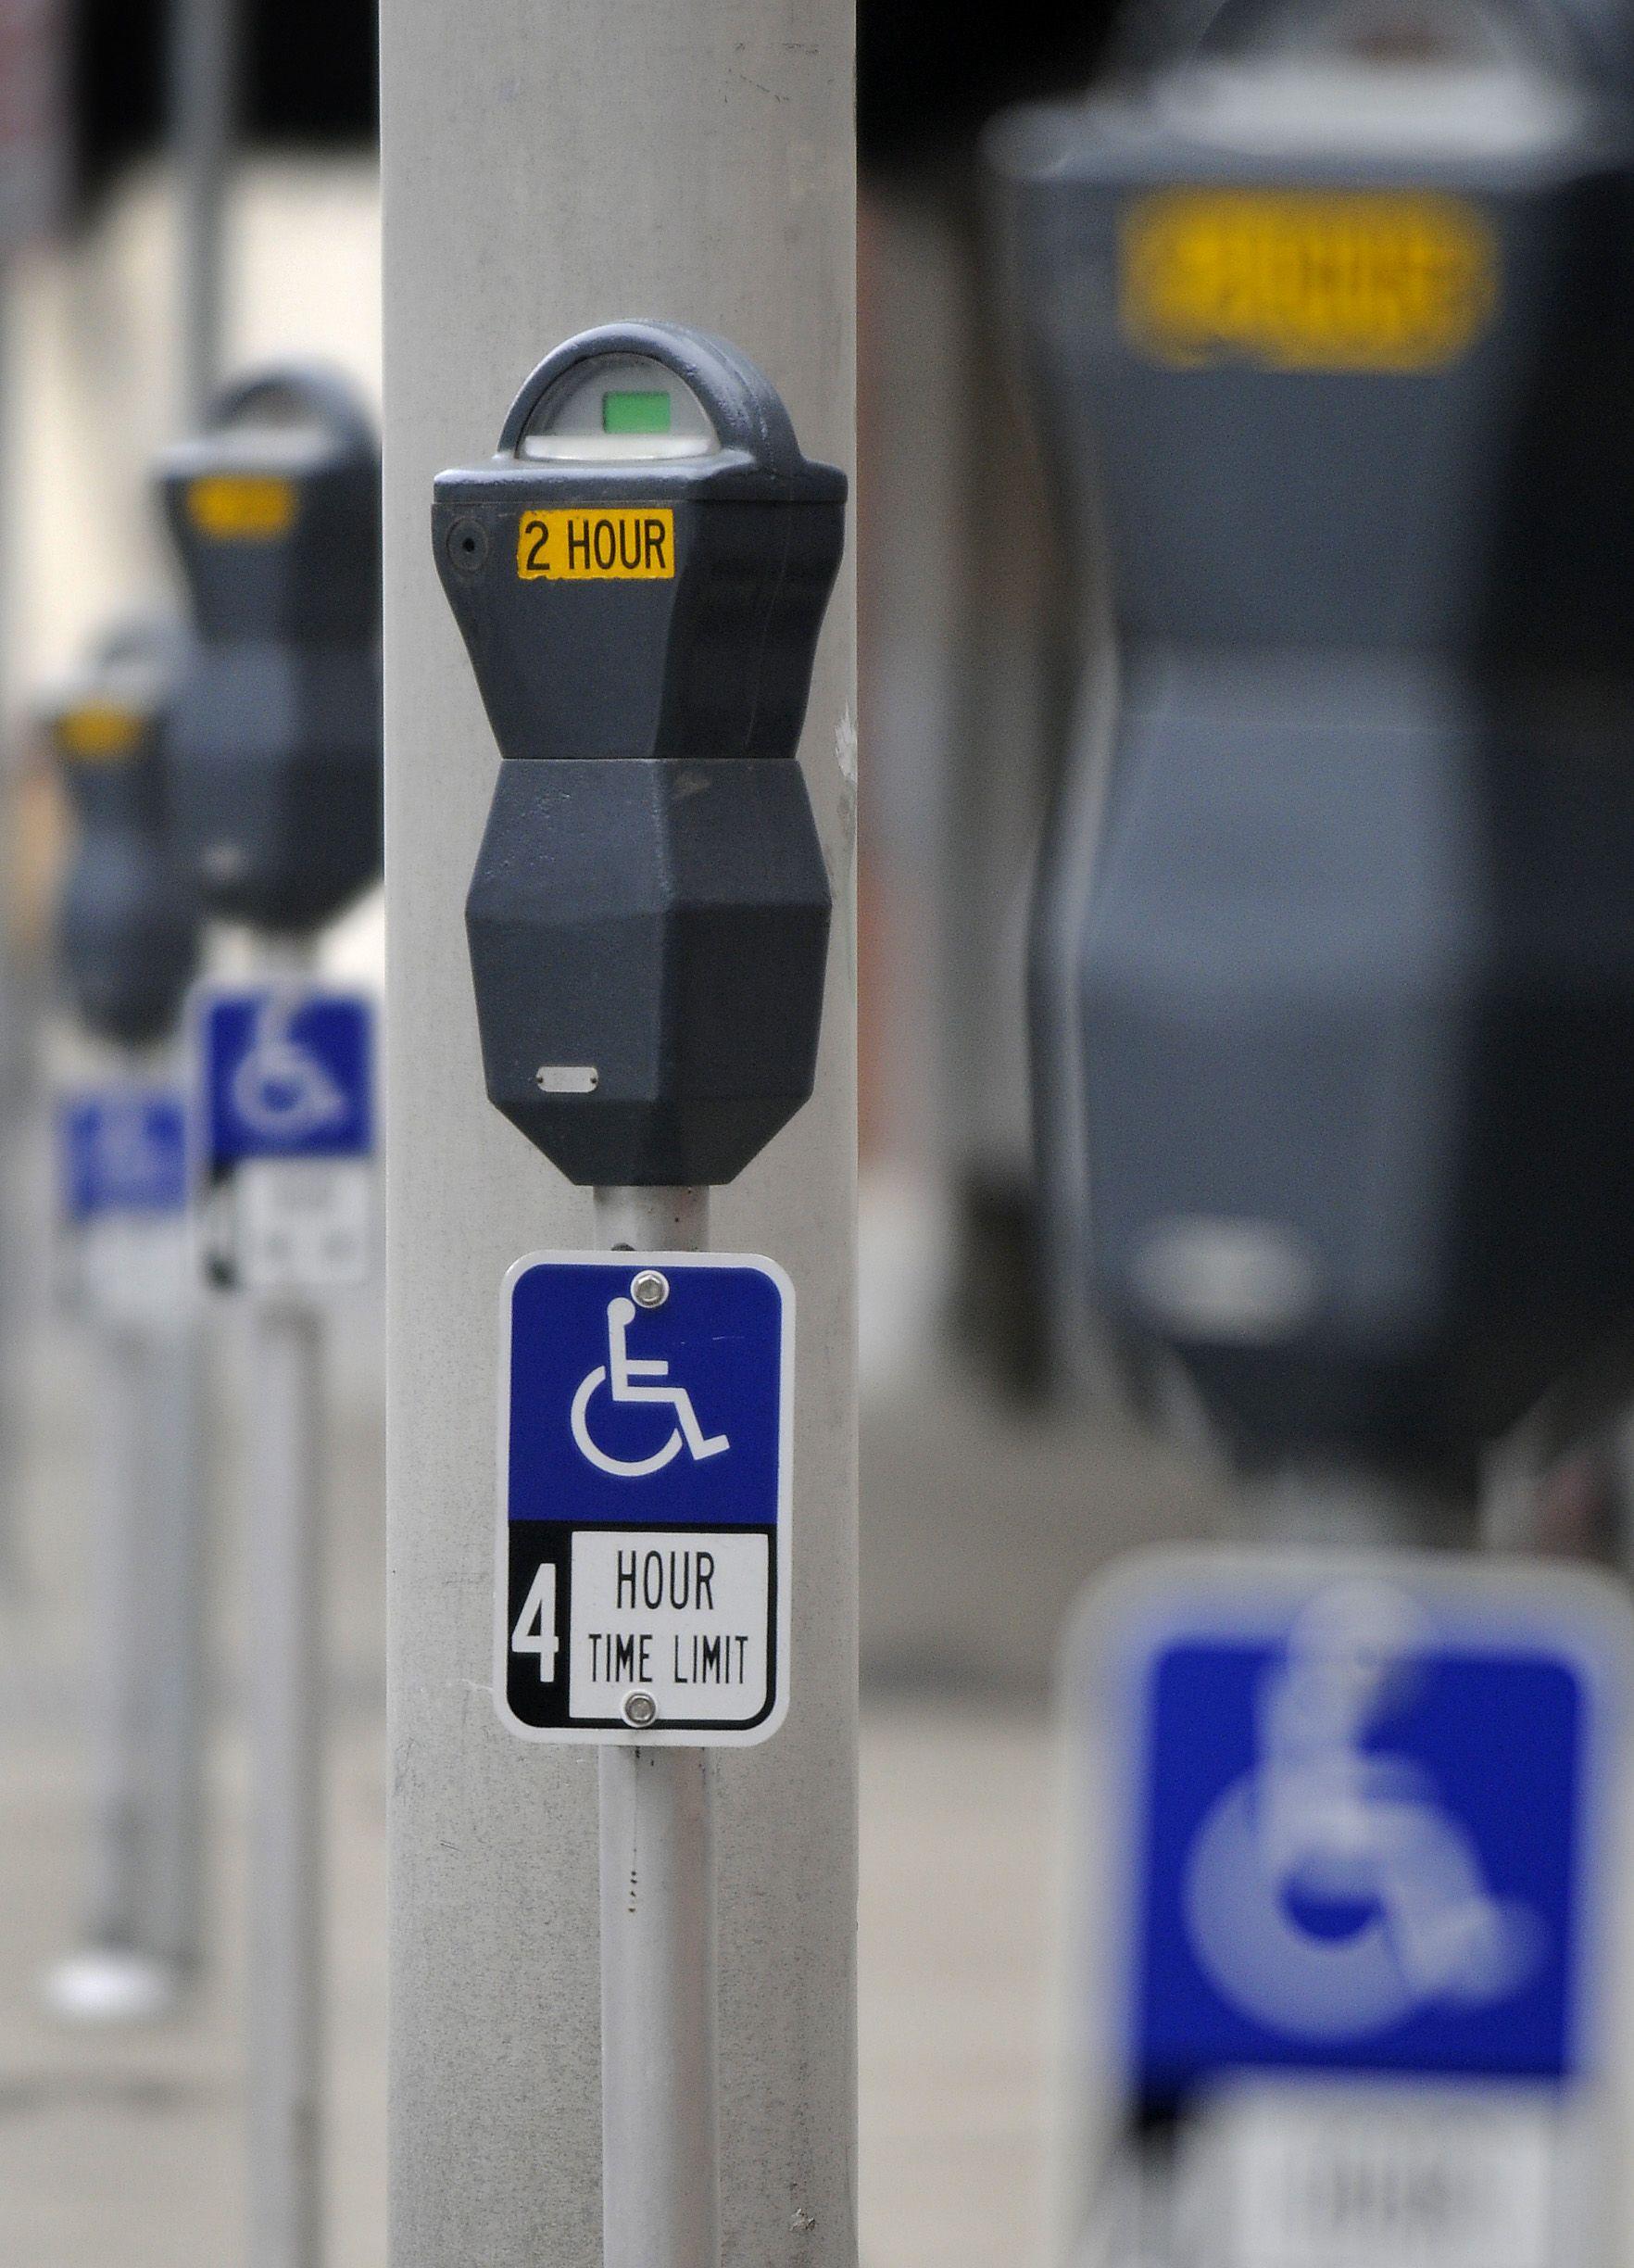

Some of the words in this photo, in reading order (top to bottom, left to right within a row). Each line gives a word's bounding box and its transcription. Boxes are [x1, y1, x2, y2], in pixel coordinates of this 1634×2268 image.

[524, 520, 550, 571] 2
[567, 519, 666, 570] HOUR
[617, 1550, 715, 1610] HOUR
[511, 1562, 559, 1683] 4
[588, 1633, 653, 1683] TIME
[673, 1634, 748, 1684] LIMIT
